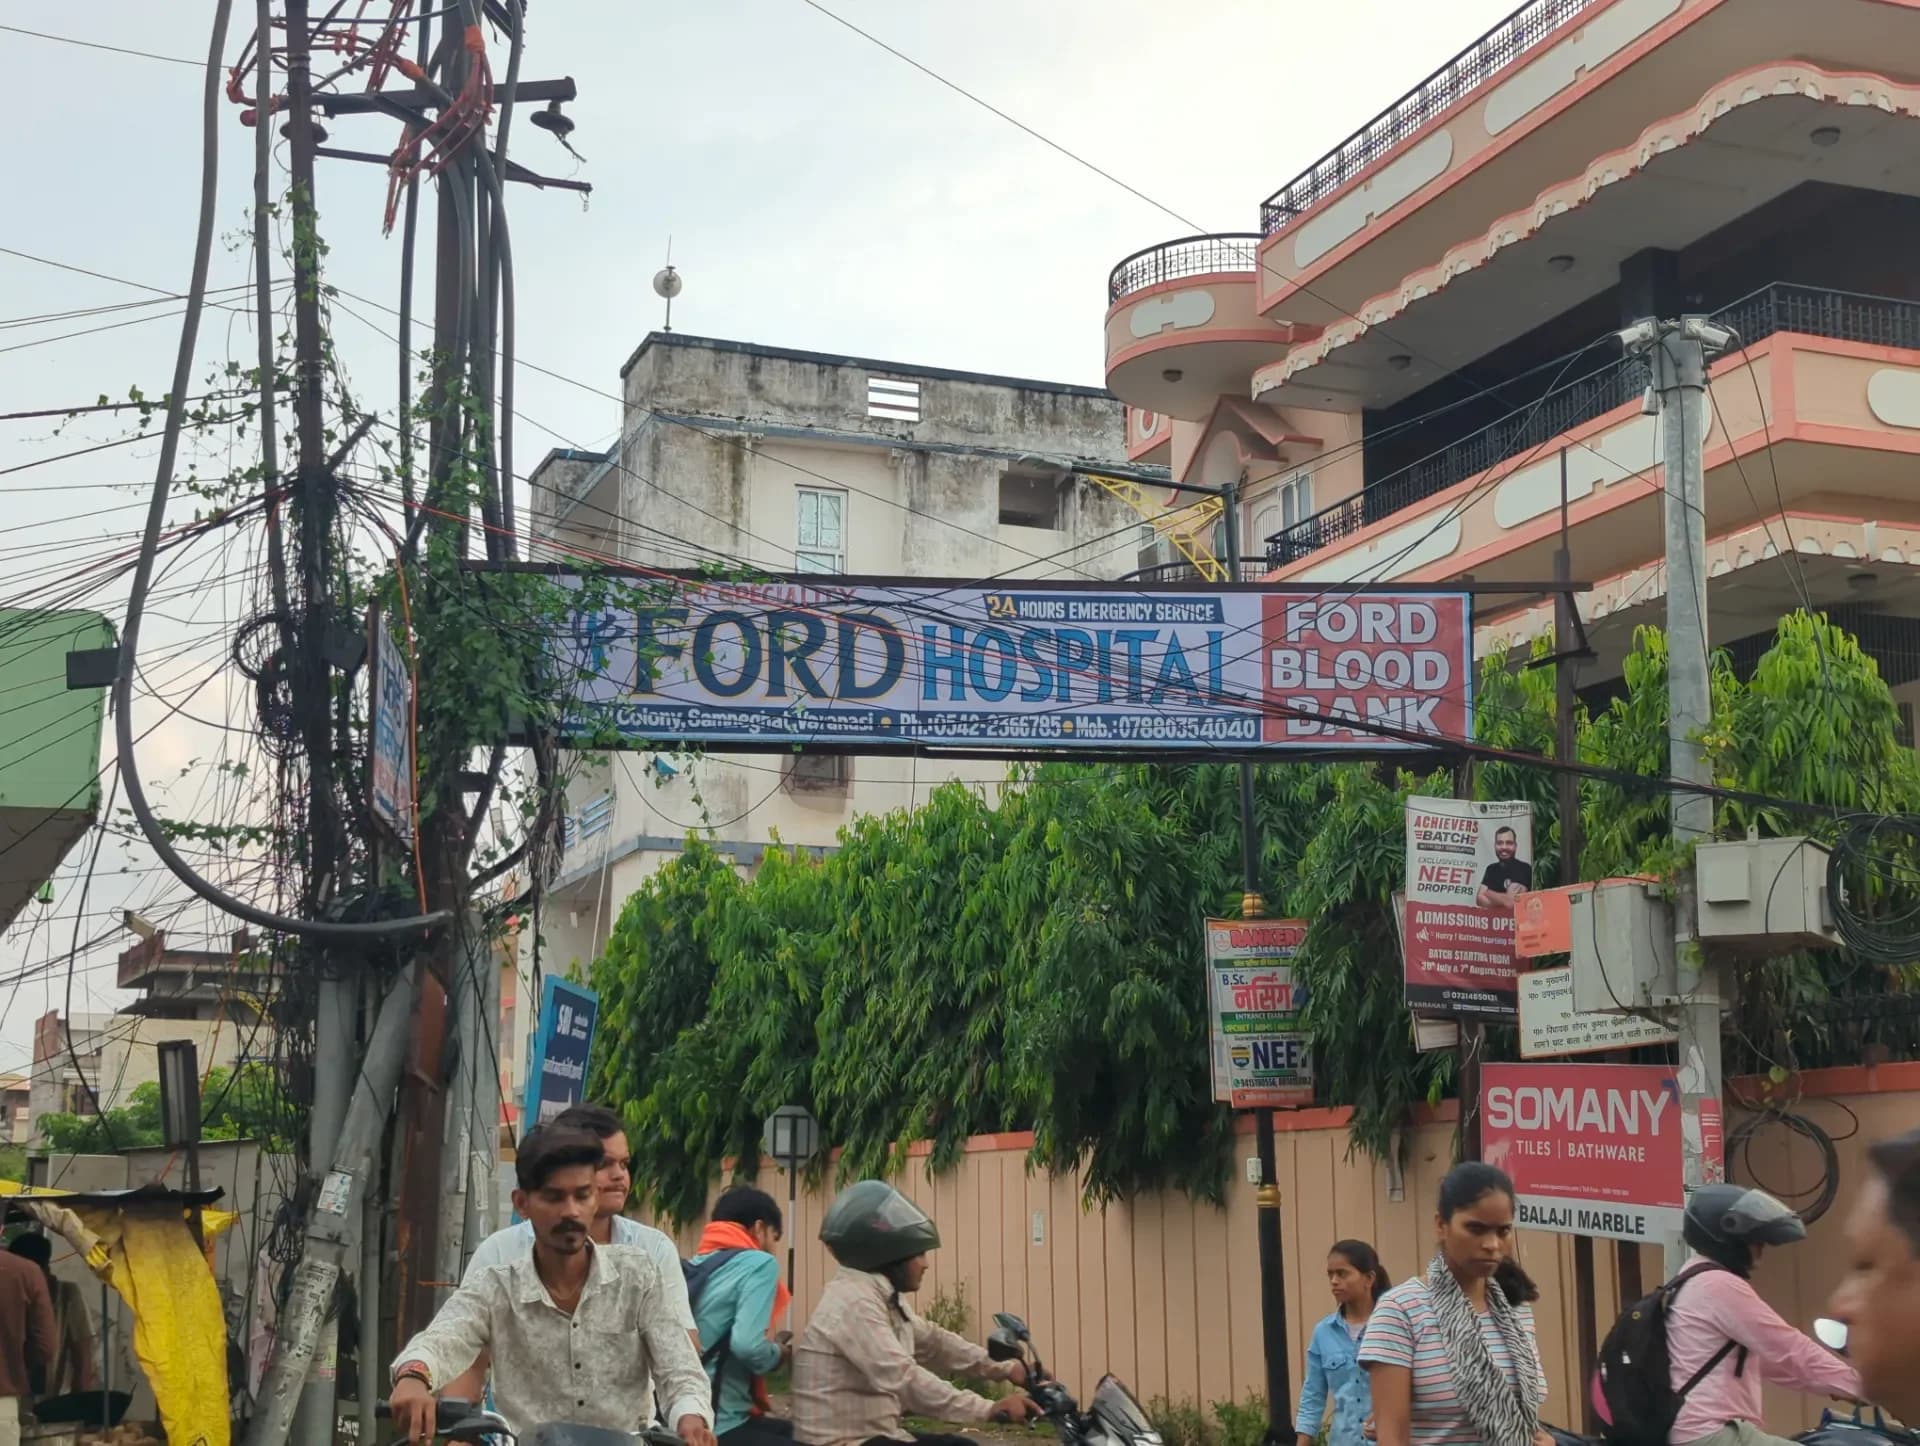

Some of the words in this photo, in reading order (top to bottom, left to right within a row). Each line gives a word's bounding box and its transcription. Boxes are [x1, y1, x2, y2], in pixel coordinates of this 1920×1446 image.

[987, 595, 1017, 618] 24
[1020, 602, 1064, 619] HOURS
[1069, 603, 1152, 621] EMERGENCY
[1156, 604, 1214, 622] SERVICE
[1286, 602, 1438, 644] FORD
[634, 607, 905, 700] FORD
[1271, 649, 1450, 691] BLOOD
[1286, 696, 1442, 737] BANK
[1414, 815, 1479, 833] ACHIEVERS
[1422, 831, 1471, 845] BATCH
[1418, 865, 1475, 885] NEET
[1417, 883, 1474, 896] DROPPERS
[1416, 910, 1489, 930] ADMISSIONS
[1492, 917, 1515, 931] OPE
[1222, 973, 1248, 986] B.Sc.
[1487, 1086, 1670, 1136] SOMANY
[1516, 1139, 1551, 1157] TILES
[1568, 1142, 1646, 1163] BATHWARE
[1519, 1204, 1573, 1228] BALAJI
[1577, 1209, 1646, 1235] MARBLE
